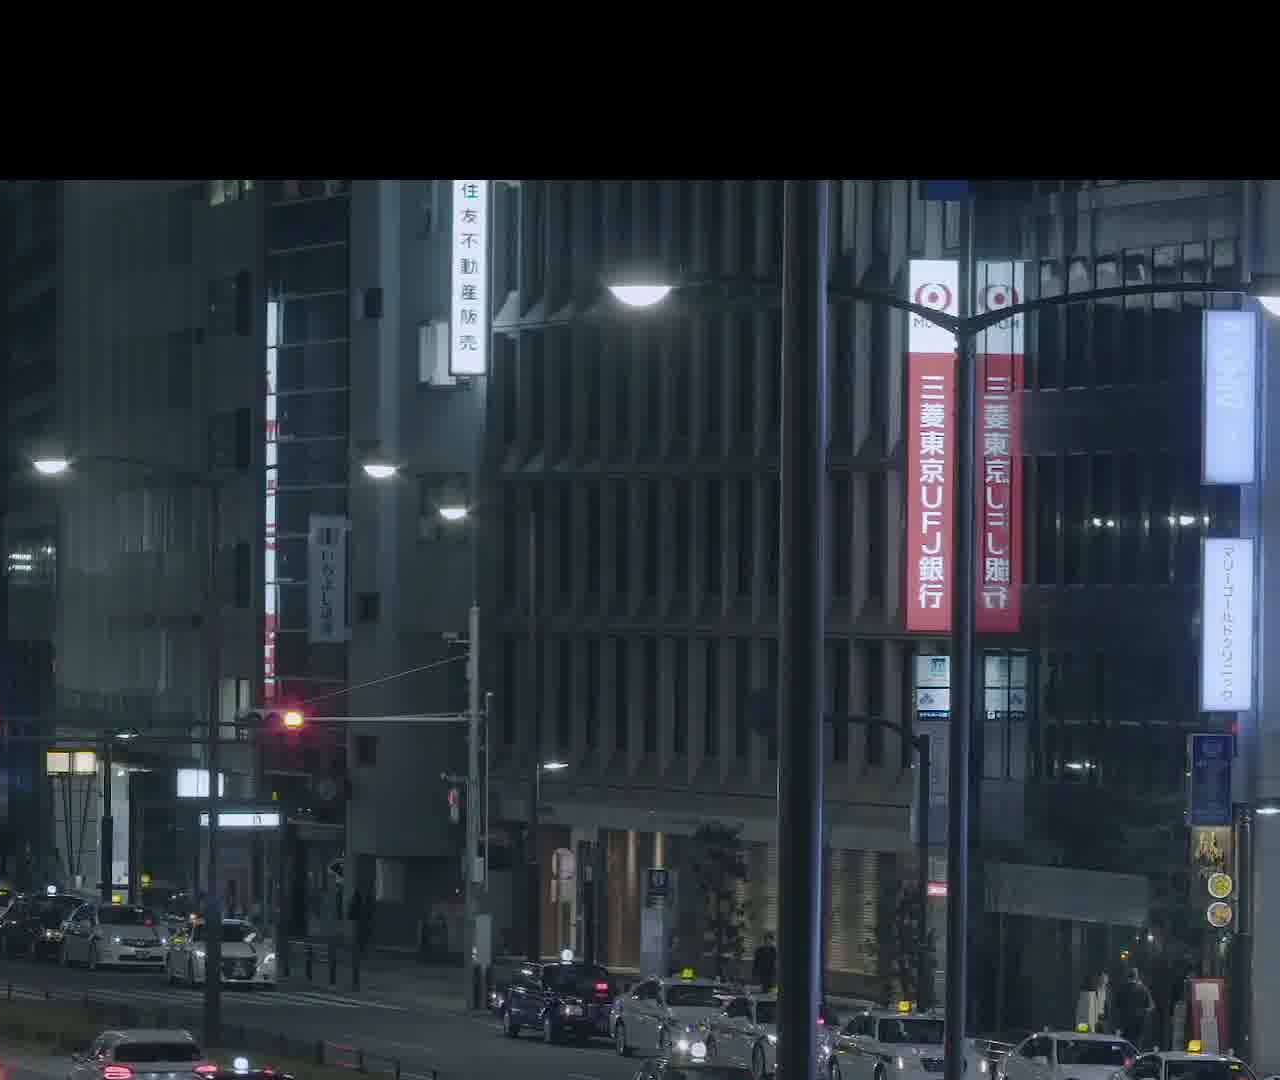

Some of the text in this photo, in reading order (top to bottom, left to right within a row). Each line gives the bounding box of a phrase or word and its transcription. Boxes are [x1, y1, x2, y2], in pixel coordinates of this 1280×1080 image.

[460, 183, 480, 351] 住友不動産販売
[919, 375, 946, 610] 三菱東京UFJ銀行
